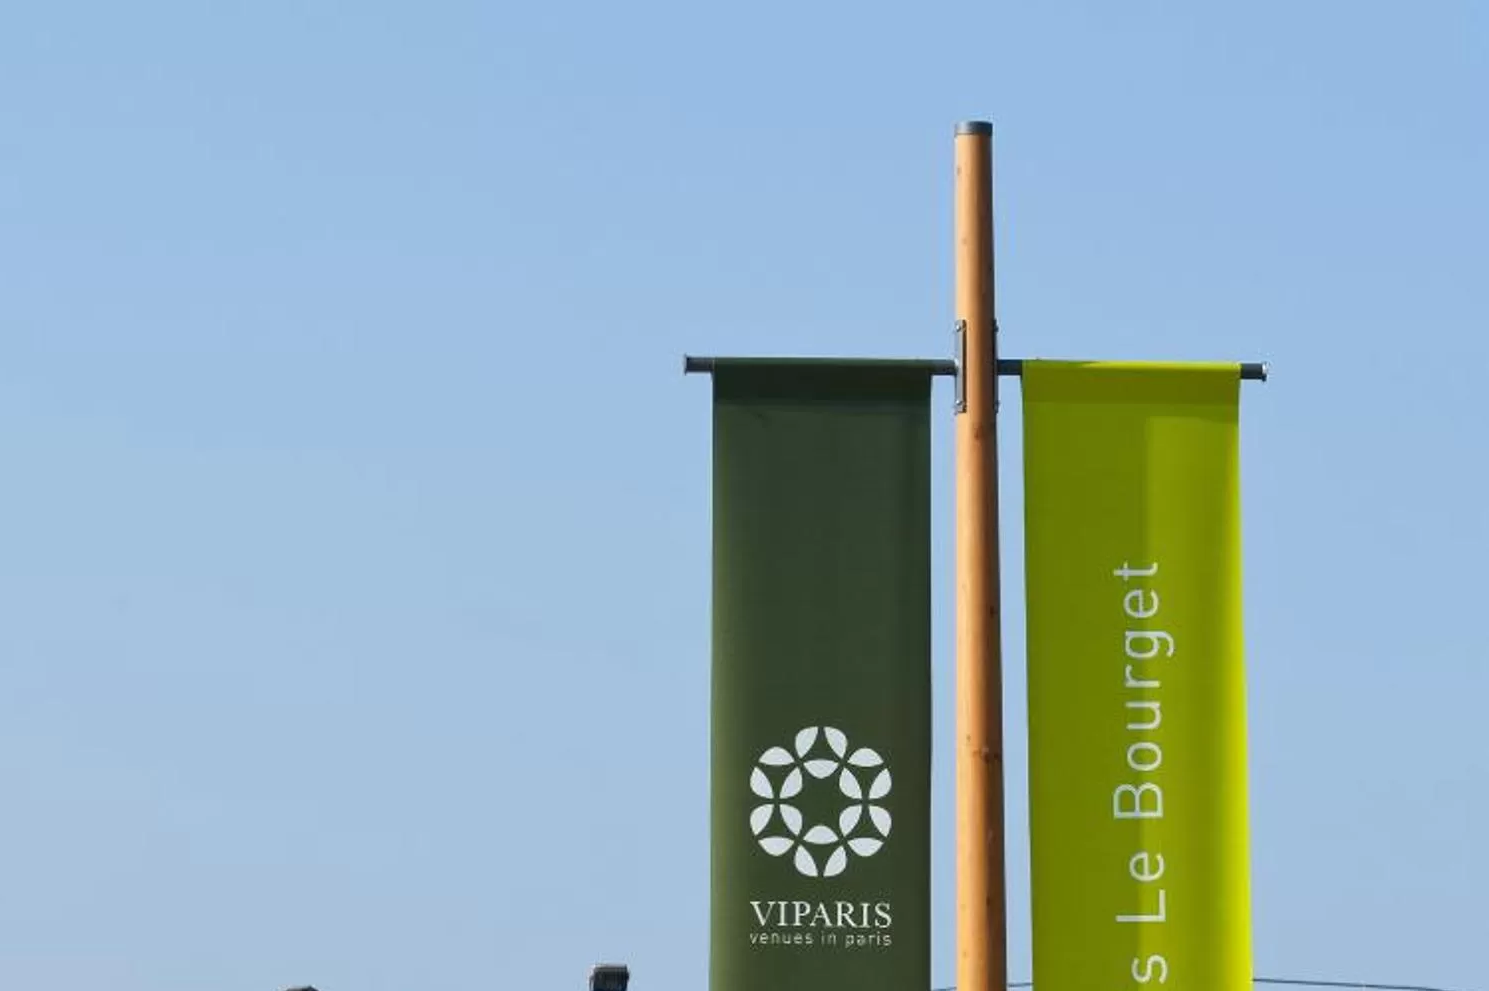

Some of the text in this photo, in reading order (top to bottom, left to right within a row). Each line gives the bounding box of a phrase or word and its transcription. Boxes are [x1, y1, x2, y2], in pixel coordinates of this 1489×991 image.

[1112, 560, 1177, 820] Bourget
[1114, 850, 1167, 924] Le
[749, 900, 893, 929] VIPARIS
[749, 931, 893, 949] venues in paris
